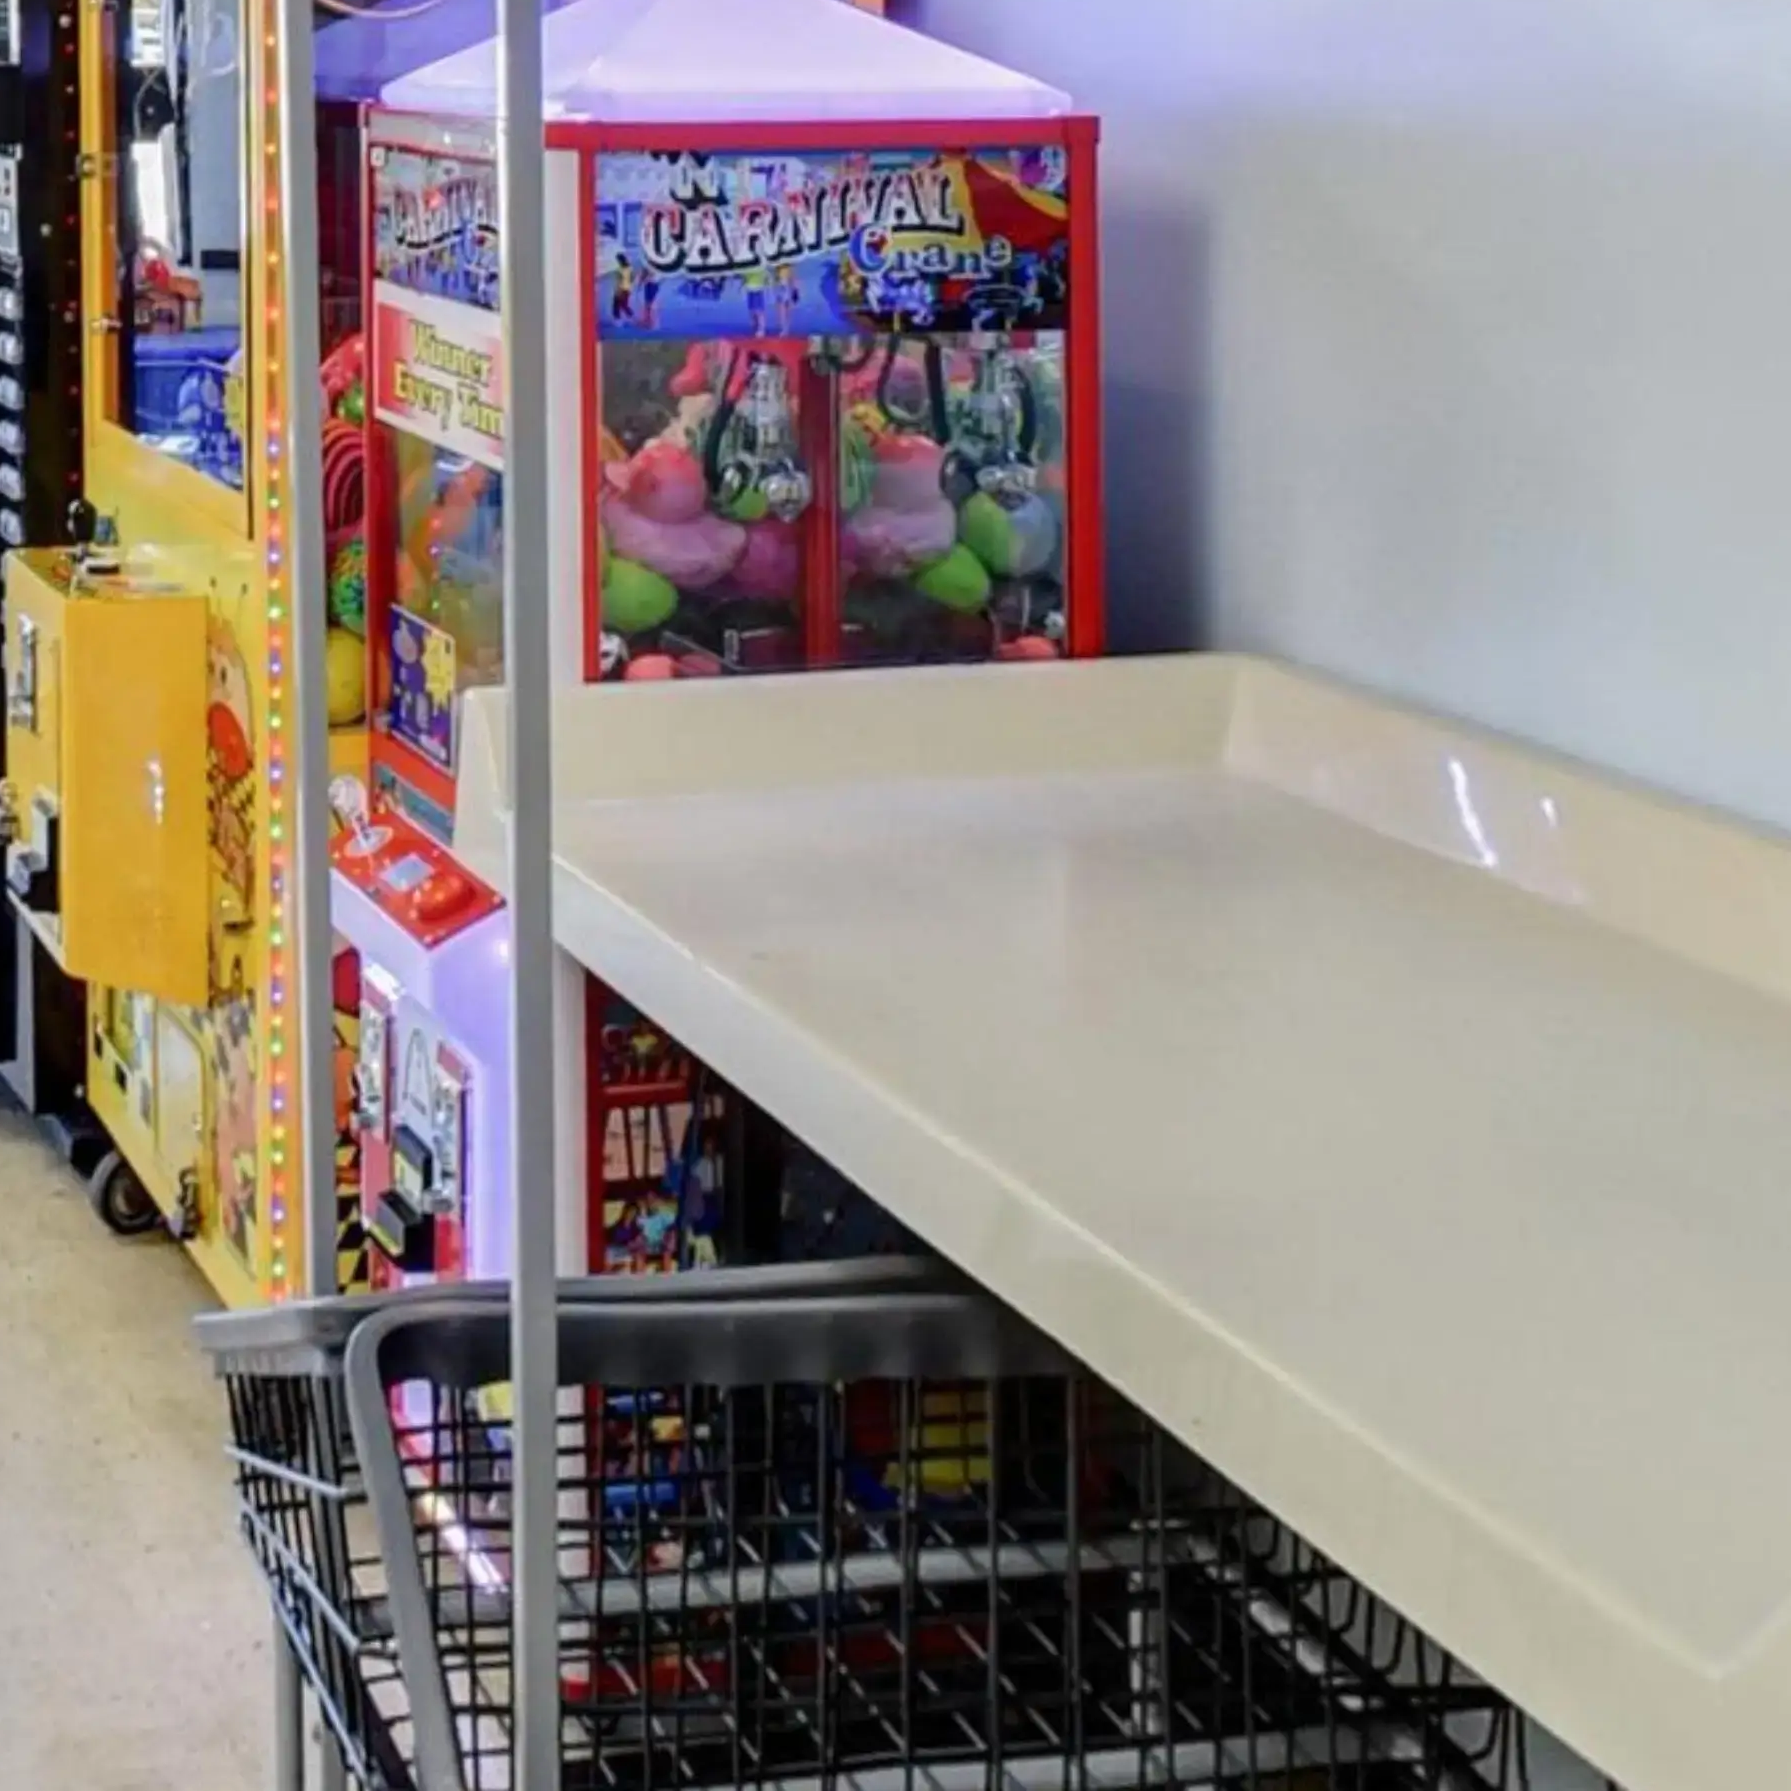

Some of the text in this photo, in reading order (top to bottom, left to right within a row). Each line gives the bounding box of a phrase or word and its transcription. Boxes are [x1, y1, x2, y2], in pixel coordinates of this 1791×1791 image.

[639, 167, 963, 273] CARNIVAL
[849, 221, 1014, 280] Crane
[409, 317, 493, 388] Winner
[393, 357, 504, 441] Every Tim
